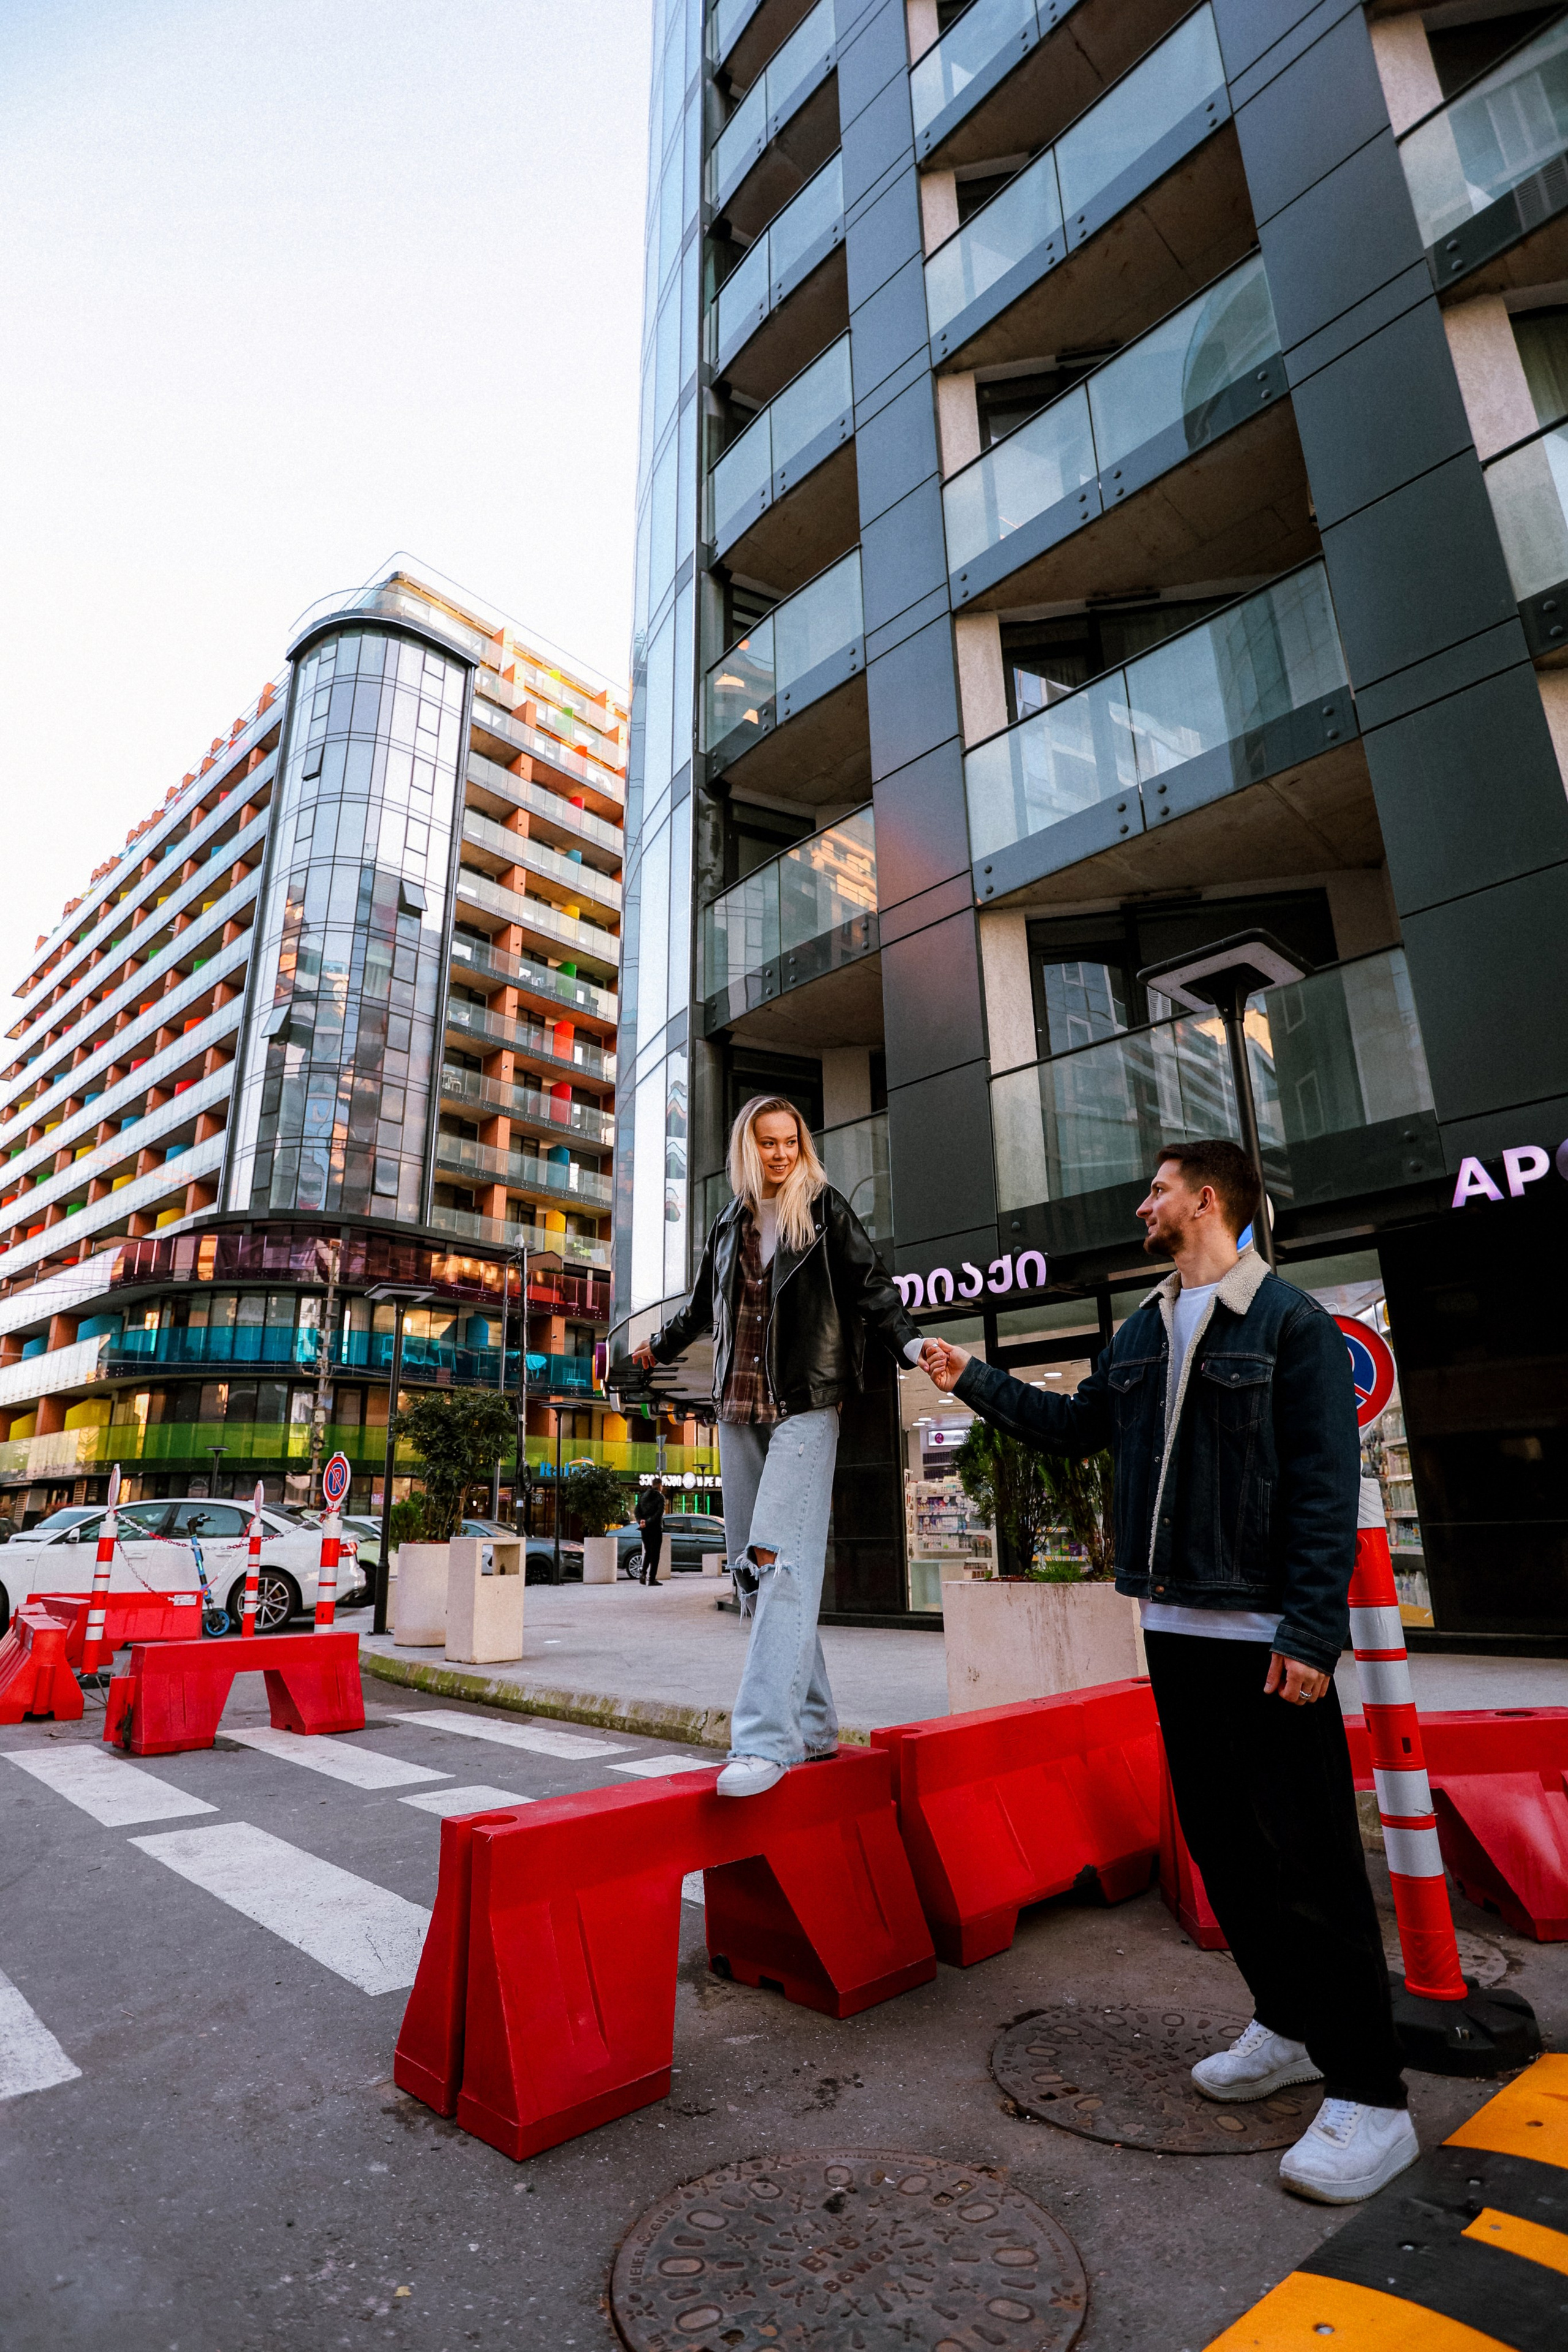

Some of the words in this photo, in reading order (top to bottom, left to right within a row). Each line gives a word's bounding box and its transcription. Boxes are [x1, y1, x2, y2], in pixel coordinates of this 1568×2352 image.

[629, 2248, 648, 2286] MEIER
[650, 2204, 682, 2231] GUSS
[797, 2236, 860, 2274] BTS
[823, 2243, 894, 2293] sewer
